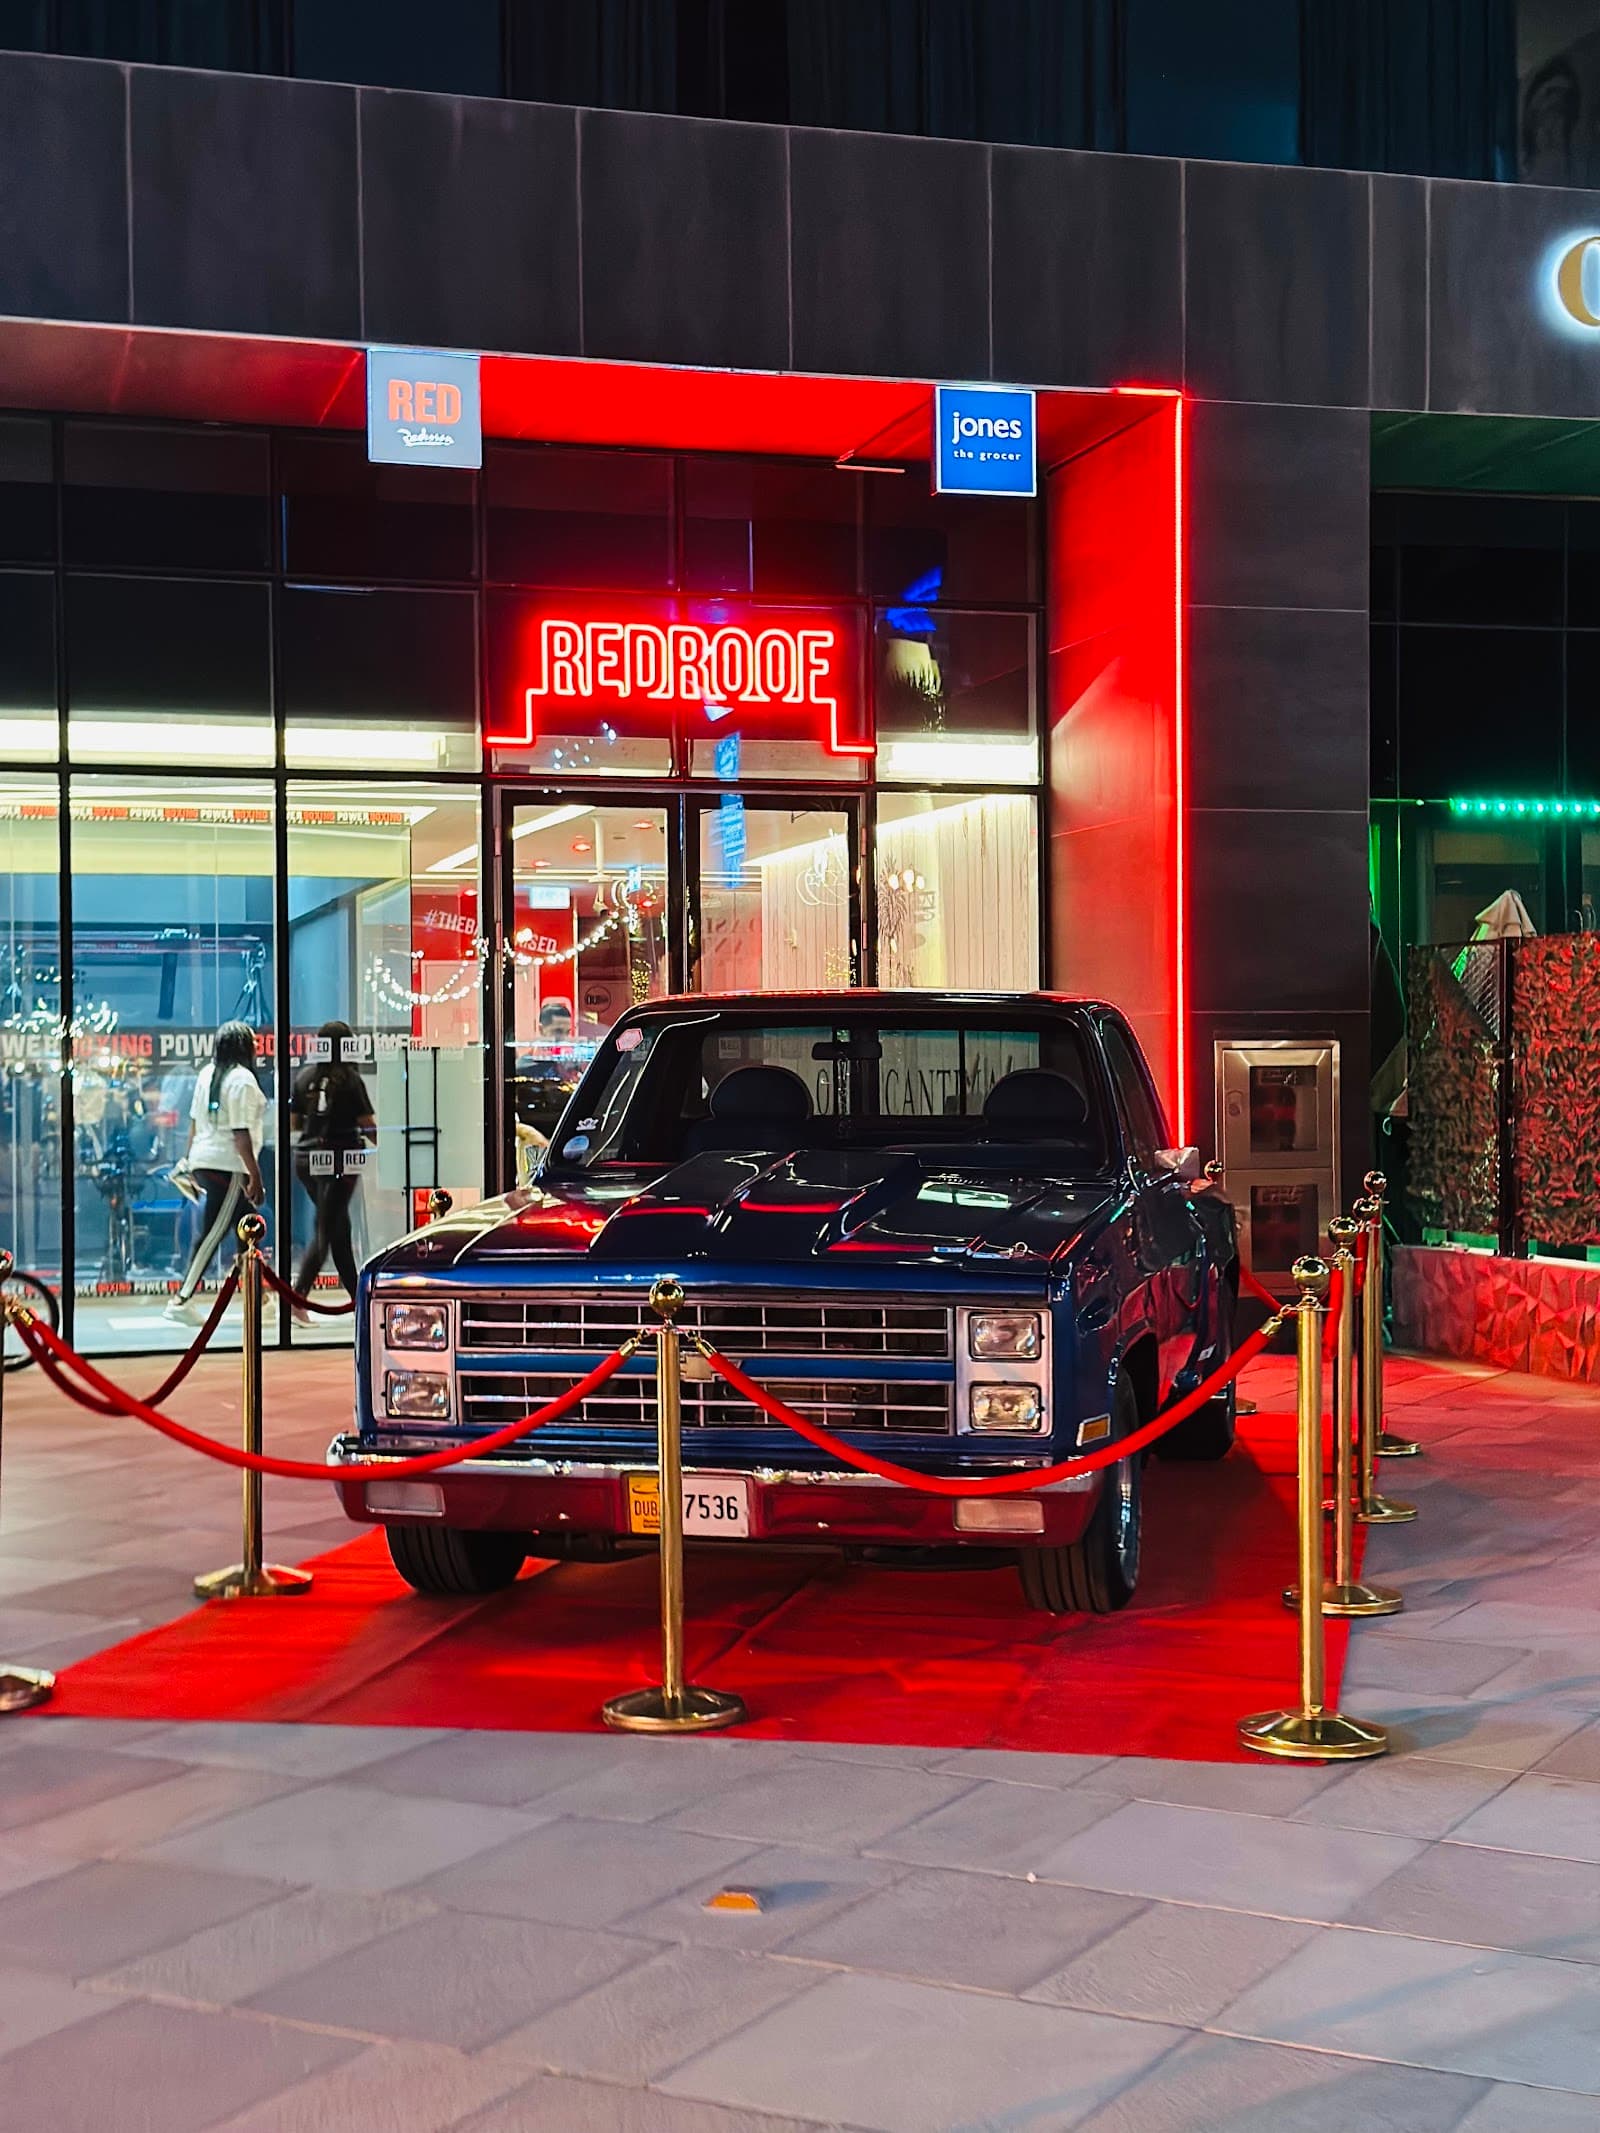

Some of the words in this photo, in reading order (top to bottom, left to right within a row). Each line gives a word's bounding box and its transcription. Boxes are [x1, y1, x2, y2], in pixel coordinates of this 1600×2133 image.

[388, 379, 462, 425] RED
[951, 411, 1022, 445] jones
[953, 449, 974, 459] the
[979, 452, 1021, 461] grocer
[541, 620, 834, 702] REDROOF
[312, 1154, 333, 1166] RED
[345, 1152, 366, 1165] RED
[634, 1500, 659, 1517] DUB
[684, 1494, 739, 1520] 7536
